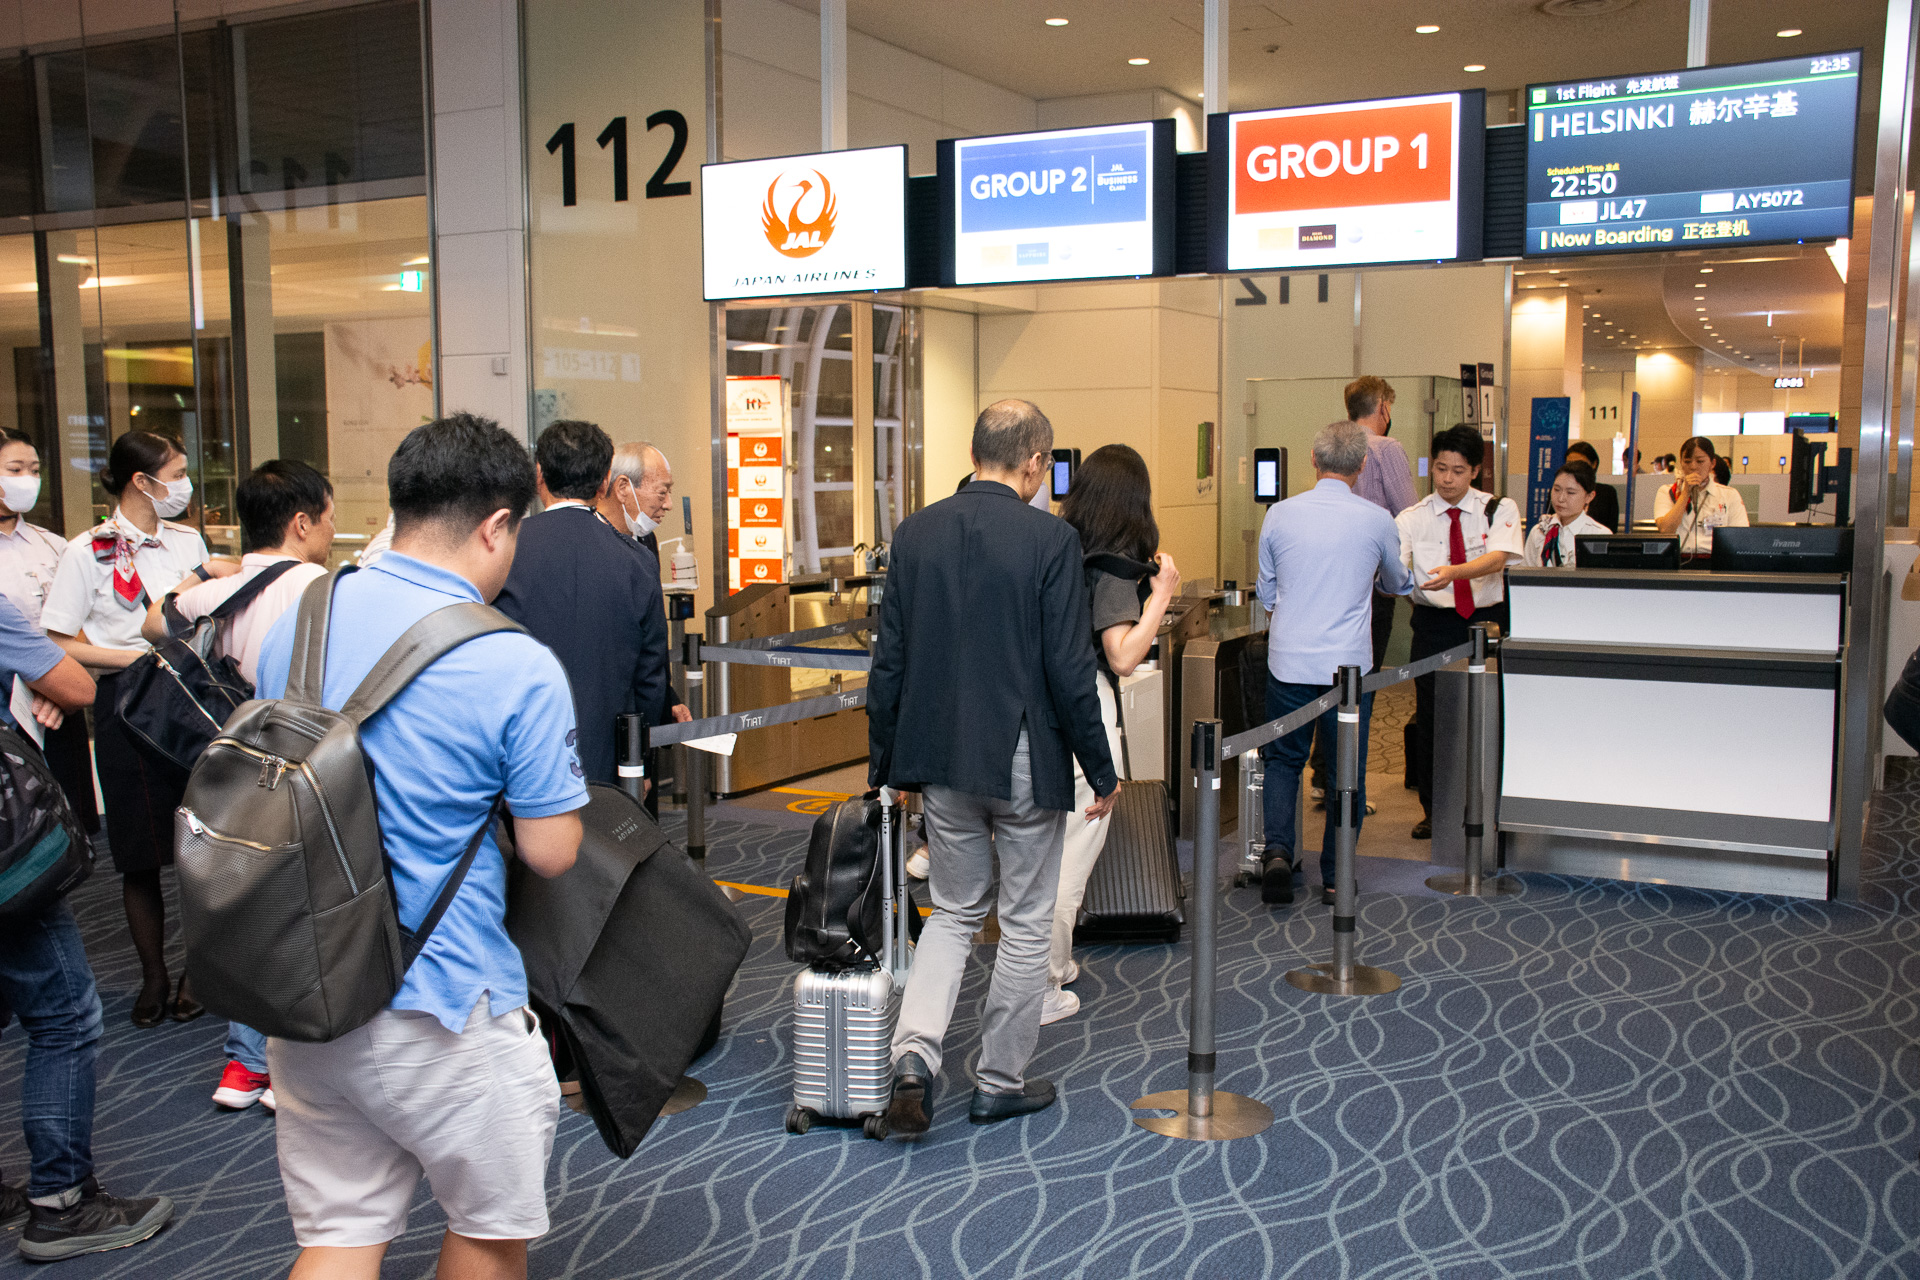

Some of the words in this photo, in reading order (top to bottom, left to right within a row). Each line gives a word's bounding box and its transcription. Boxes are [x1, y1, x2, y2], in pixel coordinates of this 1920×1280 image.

[1810, 57, 1850, 74] 22:35
[1556, 87, 1576, 101] 1st
[1578, 83, 1617, 99] Flight
[1550, 103, 1674, 138] HELSINKI
[1688, 90, 1798, 126] 赫尔辛基
[545, 109, 692, 207] 112
[1246, 136, 1400, 182] GROUP
[1410, 133, 1428, 170] 1
[1547, 166, 1585, 177] Scheduled
[1585, 164, 1605, 174] Time
[970, 168, 1066, 200] GROUP
[1071, 166, 1087, 192] 2
[1550, 173, 1617, 198] 22:50
[1600, 199, 1647, 220] JL47
[1735, 190, 1804, 210] AY5072
[780, 230, 825, 251] JAL
[1301, 234, 1334, 242] DIAMOND
[1551, 230, 1591, 248] Now
[1595, 221, 1673, 246] Boarding
[1682, 219, 1750, 240] 正在登机
[733, 275, 786, 288] JAPAN
[793, 268, 877, 284] AIRLINES
[1466, 394, 1475, 419] 3
[1484, 393, 1490, 417] 1
[1590, 406, 1617, 419] 111
[772, 656, 792, 666] TIAT
[844, 696, 859, 707] TIAT
[746, 716, 763, 728] TIAT
